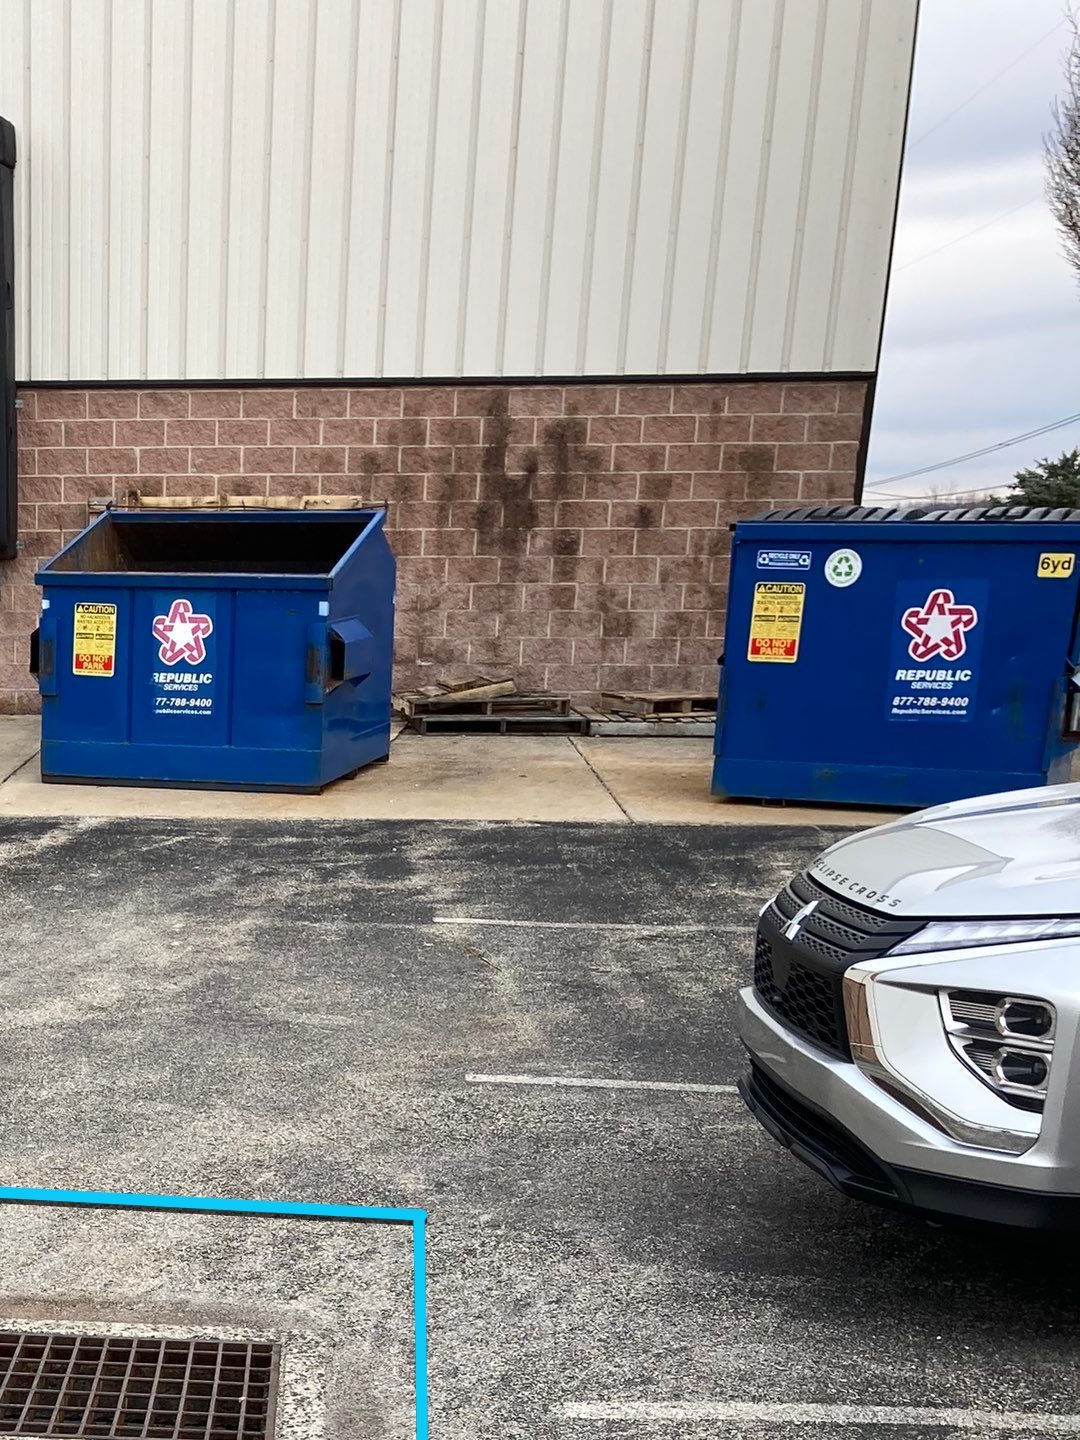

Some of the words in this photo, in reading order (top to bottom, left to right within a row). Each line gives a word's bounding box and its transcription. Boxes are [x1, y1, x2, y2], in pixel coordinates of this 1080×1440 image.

[1041, 557, 1072, 573] 6yd
[765, 584, 803, 593] CAUTION
[83, 605, 115, 613] CAUTION
[755, 639, 770, 647] DO
[771, 639, 793, 648] NOT
[759, 647, 786, 656] PARK
[79, 654, 91, 662] DO
[92, 655, 110, 663] NOT
[82, 662, 105, 670] PARK
[895, 669, 972, 681] REPUBLIC
[163, 683, 199, 691] SERVICES
[910, 681, 954, 689] SERVICES
[892, 696, 969, 706] 877-788-9400
[813, 858, 849, 885] ECLIPSE
[849, 882, 902, 907] CROSS
